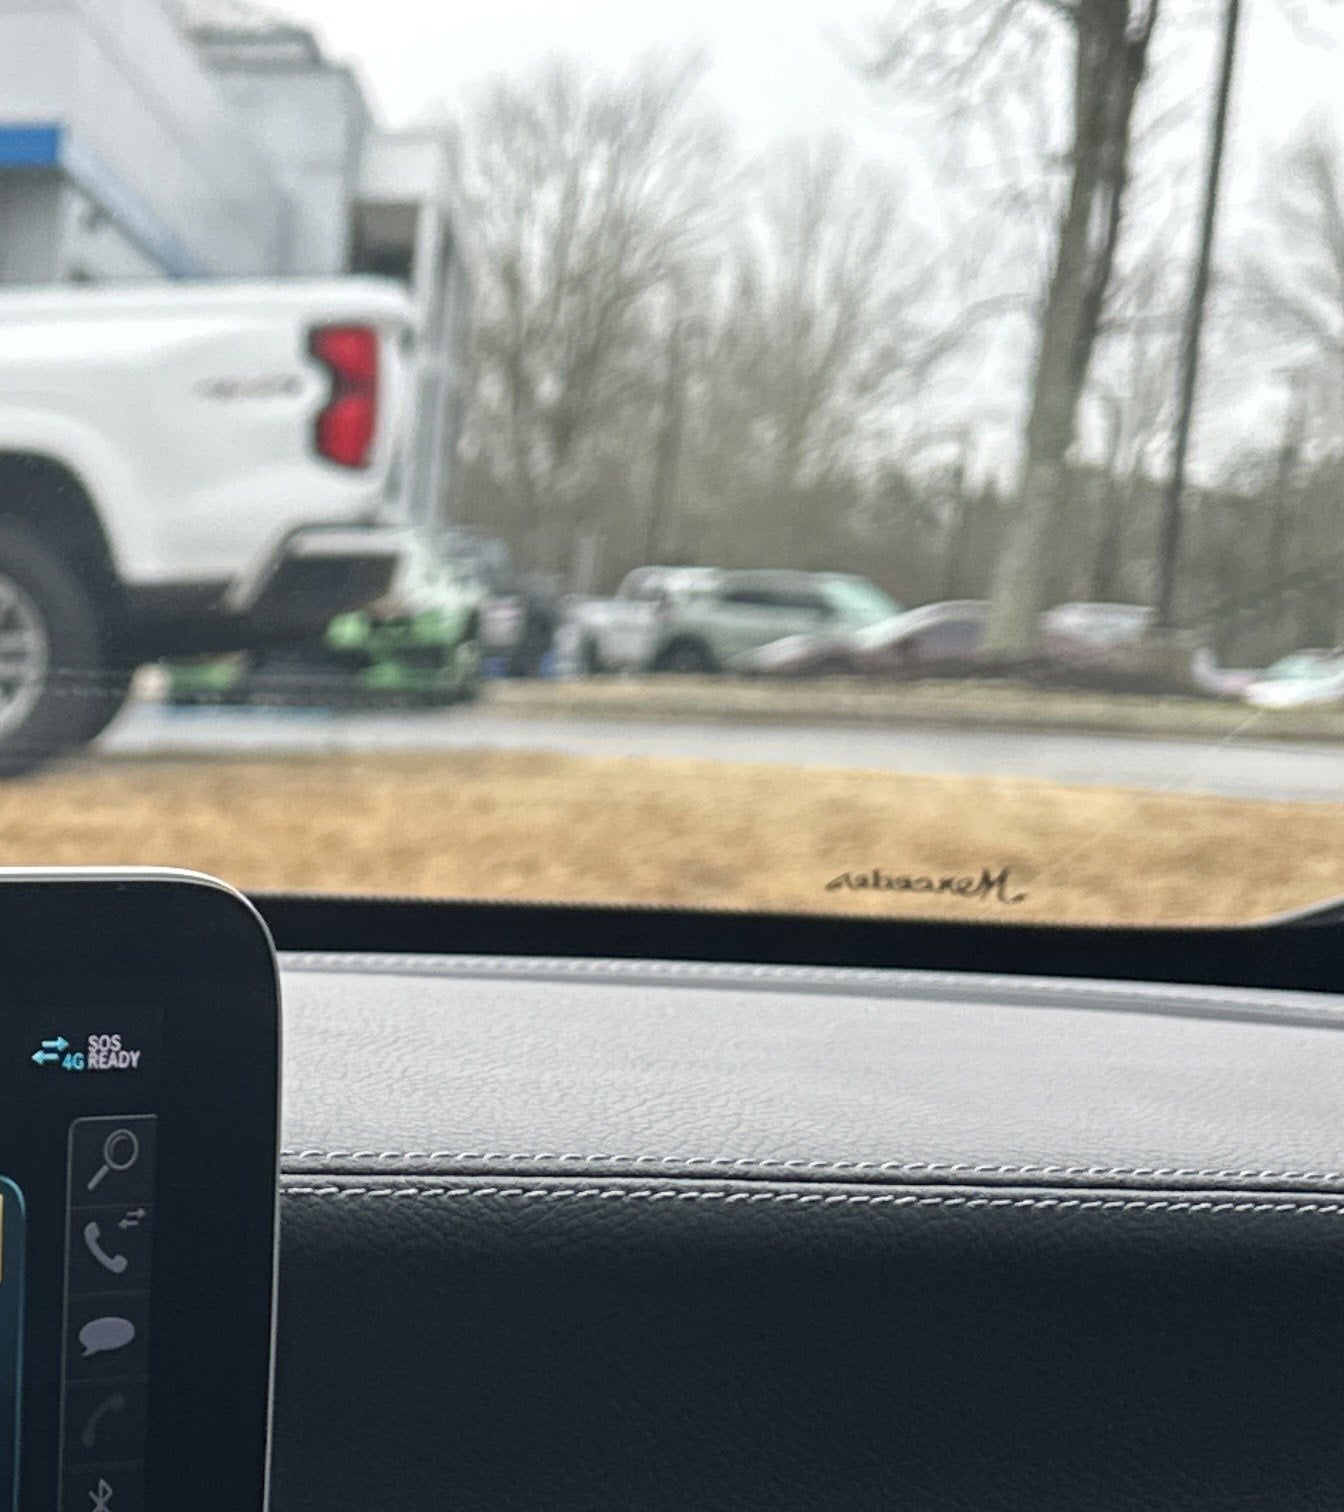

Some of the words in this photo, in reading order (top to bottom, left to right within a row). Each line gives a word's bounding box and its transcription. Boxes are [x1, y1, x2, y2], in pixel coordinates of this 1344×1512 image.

[87, 1034, 122, 1052] SOS
[62, 1052, 85, 1071] 4G
[87, 1050, 142, 1070] READY
